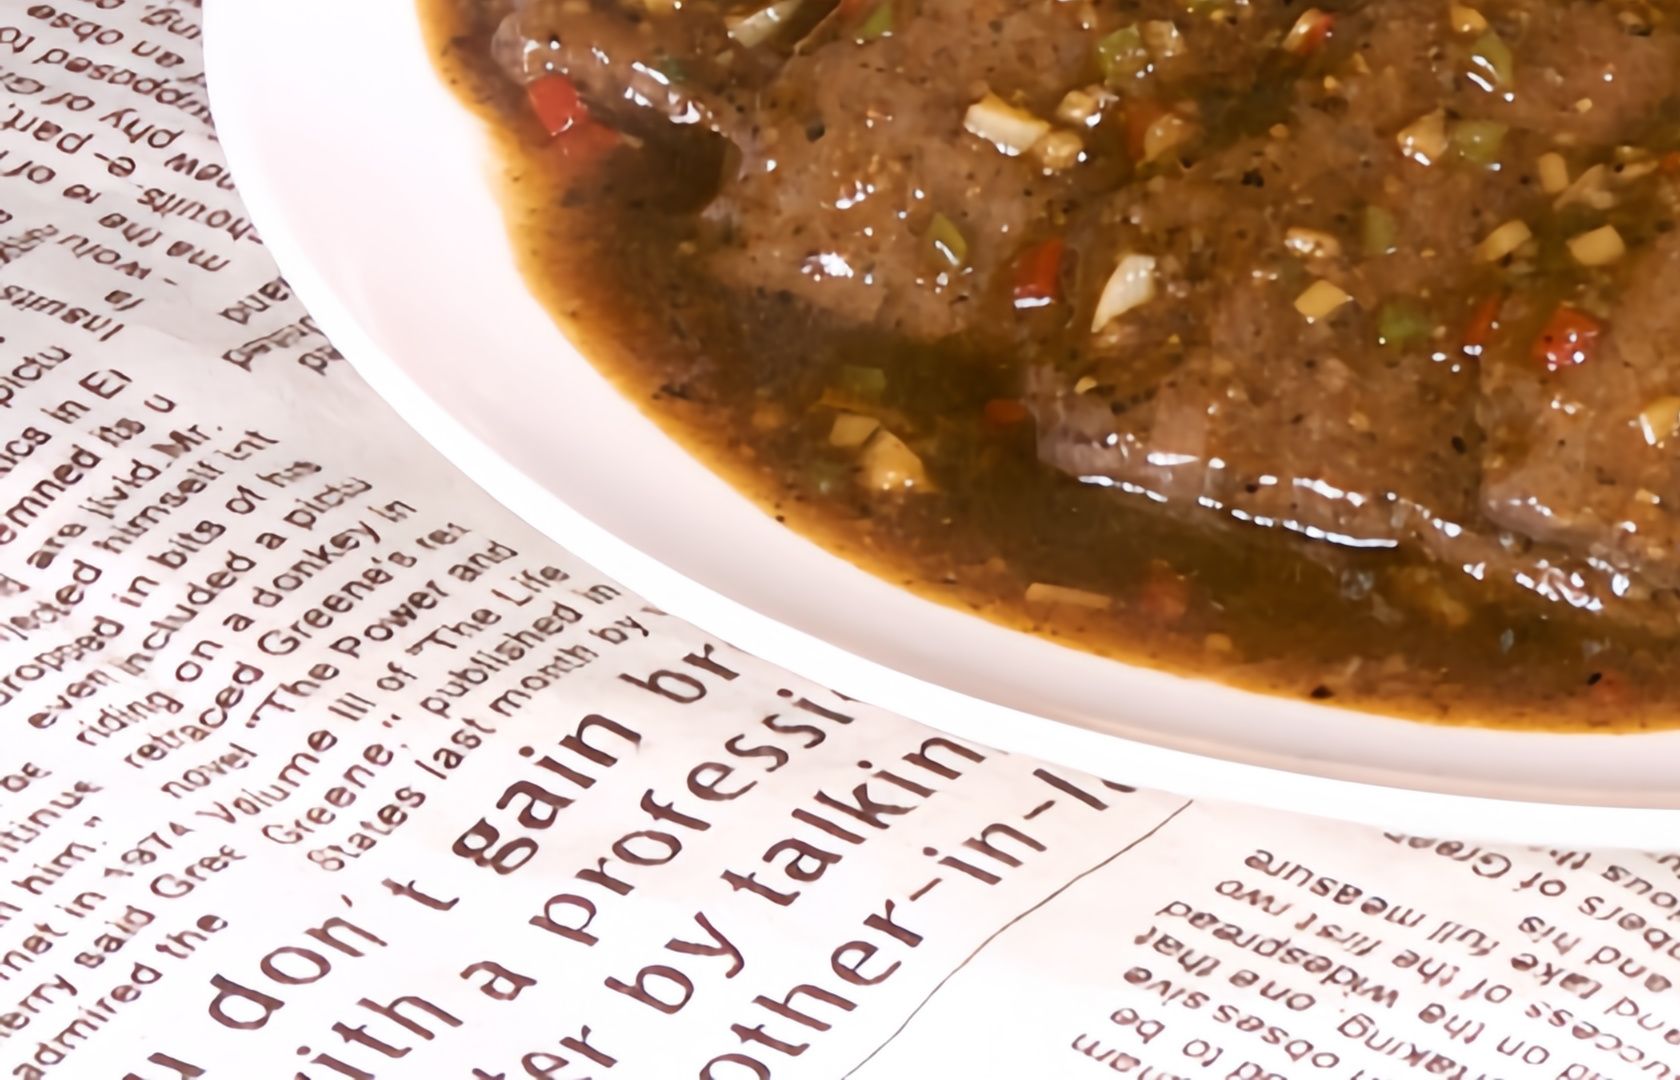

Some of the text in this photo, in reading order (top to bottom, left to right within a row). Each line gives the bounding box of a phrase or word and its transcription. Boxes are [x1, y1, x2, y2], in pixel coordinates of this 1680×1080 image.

[174, 639, 224, 683] on
[451, 713, 643, 876] gain
[294, 687, 855, 1080] ith a professi
[1244, 849, 1427, 928] measure
[603, 910, 746, 1015] by
[1517, 915, 1581, 956] his
[1228, 969, 1317, 1012] one
[1109, 1008, 1166, 1045] be
